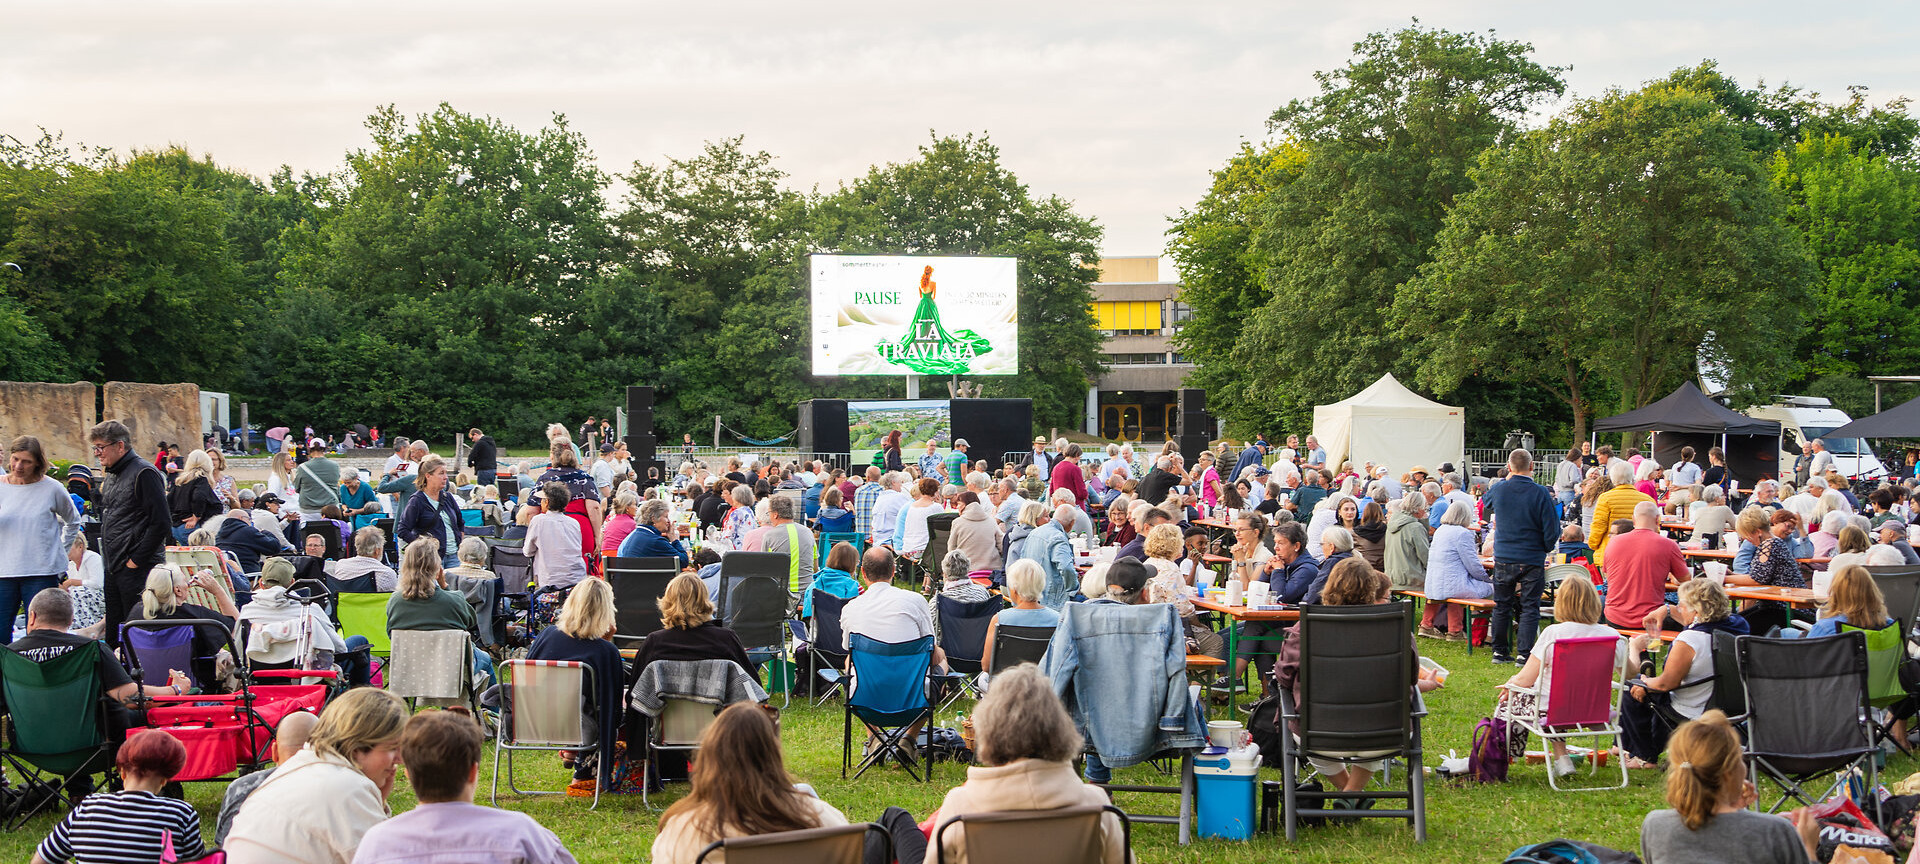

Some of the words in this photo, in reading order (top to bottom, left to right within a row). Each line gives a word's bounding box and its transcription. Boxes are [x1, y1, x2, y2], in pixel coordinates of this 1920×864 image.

[855, 291, 902, 305] PAUSE
[914, 322, 942, 341] LA
[879, 341, 978, 360] TRAVIATA
